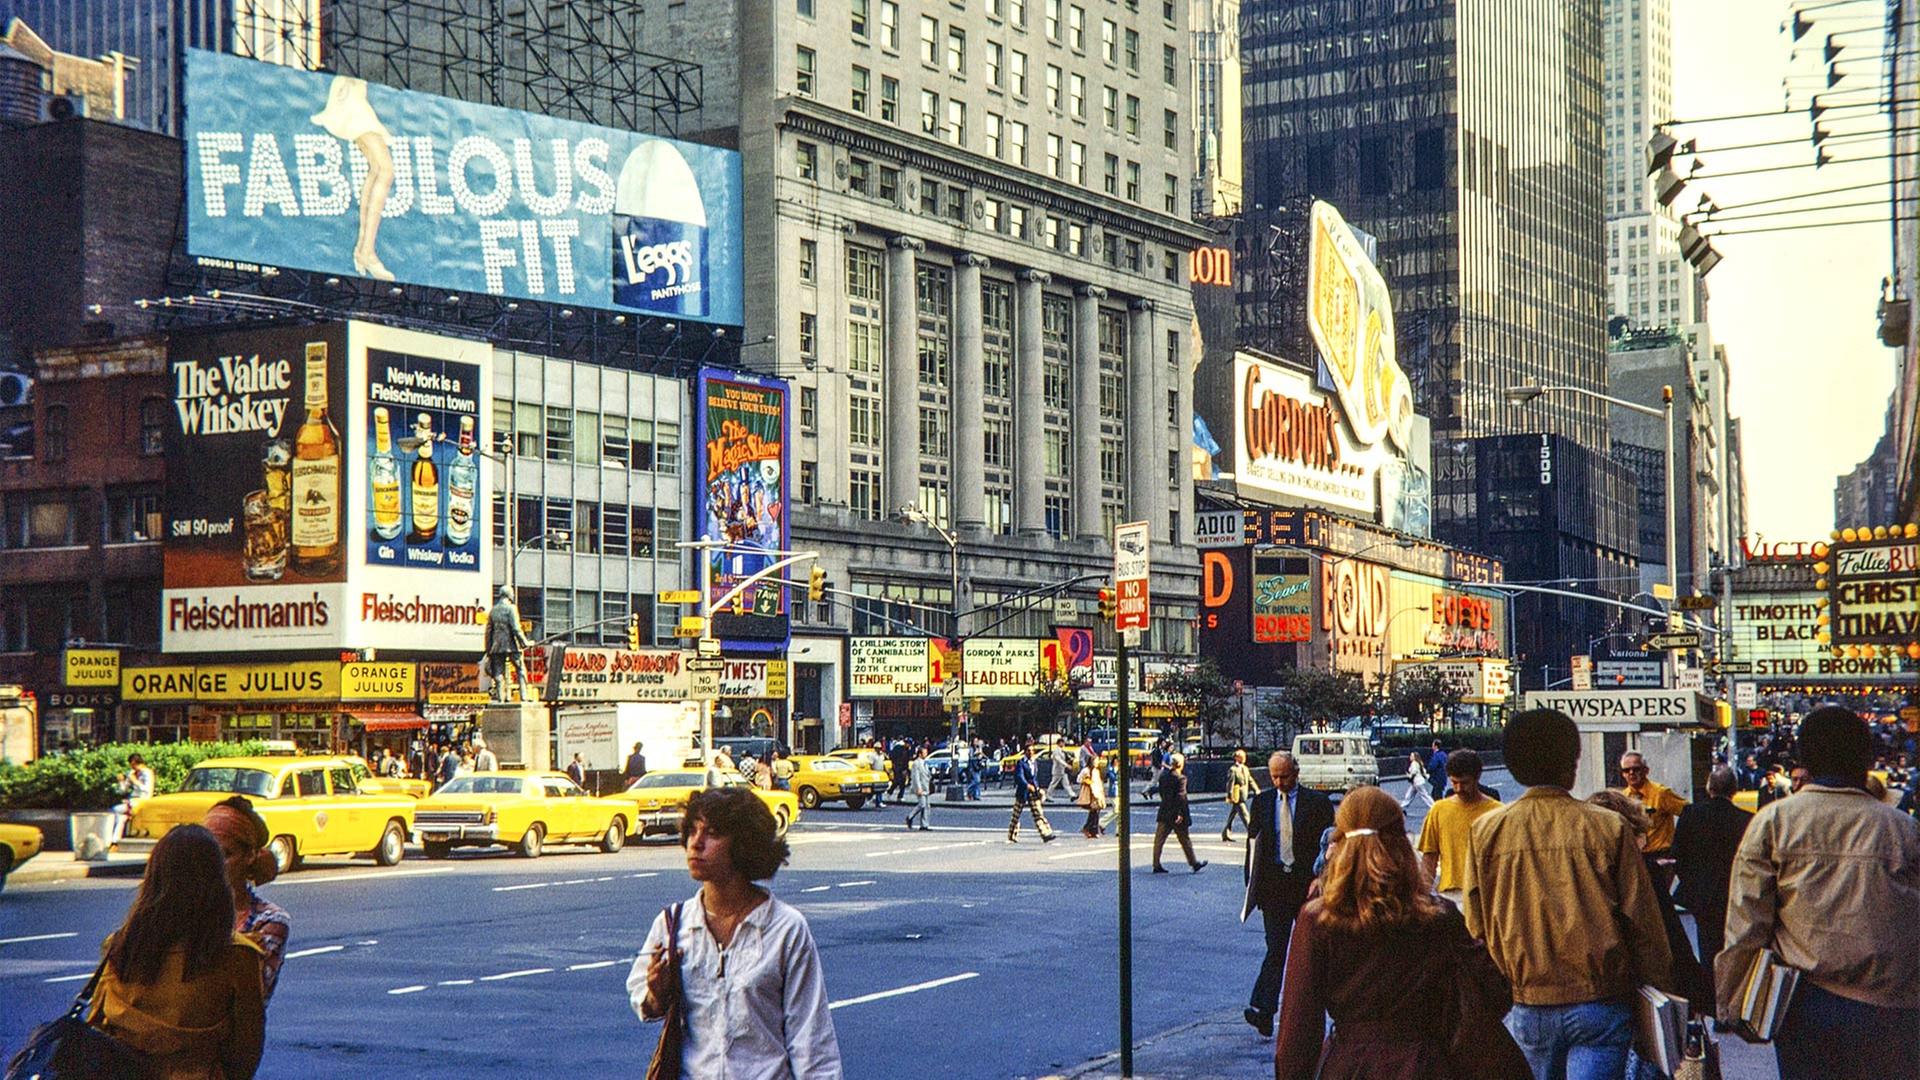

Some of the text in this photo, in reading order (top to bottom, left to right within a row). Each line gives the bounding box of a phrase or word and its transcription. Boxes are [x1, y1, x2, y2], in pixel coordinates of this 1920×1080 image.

[196, 132, 616, 217] FABULOUS
[480, 219, 579, 294] FIT
[620, 234, 692, 286] L'eggs
[197, 257, 234, 269] DOUGLAS
[236, 262, 259, 273] LEIGH
[651, 281, 702, 300] PANTYHOSE
[173, 354, 291, 398] The Value
[387, 366, 460, 393] New York is a
[371, 383, 475, 412] Fleischmann town
[725, 388, 764, 403] YOU WON'T
[708, 396, 780, 416] BELIEVE YOUR EYES!
[174, 394, 290, 438] Whiskey
[722, 420, 747, 440] The
[707, 434, 780, 481] Magic Show
[1541, 434, 1551, 484] 1500
[173, 518, 235, 538] Still 90 proof
[1194, 515, 1235, 535] ADIO
[378, 546, 475, 564] Gin Whiskey Vodka
[1837, 549, 1890, 575] Follies
[1118, 560, 1145, 576] BUS STOP
[1125, 581, 1140, 597] NO
[1322, 554, 1386, 637] BOND
[169, 592, 329, 631] Fleischmann's
[1120, 597, 1145, 614] STANDING
[1736, 604, 1823, 620] TIMOTHY
[1756, 625, 1820, 640] BLACK
[1680, 637, 1695, 645] WAY
[852, 648, 925, 656] OF CANNIBALISM
[966, 649, 1035, 657] GORDON PARKS
[70, 656, 117, 666] ORANGE
[884, 665, 923, 673] CENTURY
[1756, 659, 1808, 674] STUD
[1819, 658, 1892, 674] BROWN
[74, 669, 112, 679] JULIUS
[350, 667, 407, 679] ORANGE
[575, 673, 607, 683] CREAM
[610, 672, 623, 683] 28
[626, 674, 664, 684] FLAVORS
[699, 676, 711, 684] NO
[853, 674, 893, 684] TENDER
[964, 671, 1037, 686] LEAD BELLY
[132, 671, 323, 693] ORANGE JULIUS
[354, 682, 404, 692] JULIUS
[694, 686, 717, 694] TURNS
[894, 682, 927, 693] FLESH
[51, 694, 114, 705] BOOKS
[636, 687, 688, 698] COCKTAILS
[1535, 697, 1686, 717] NEWSPAPERS
